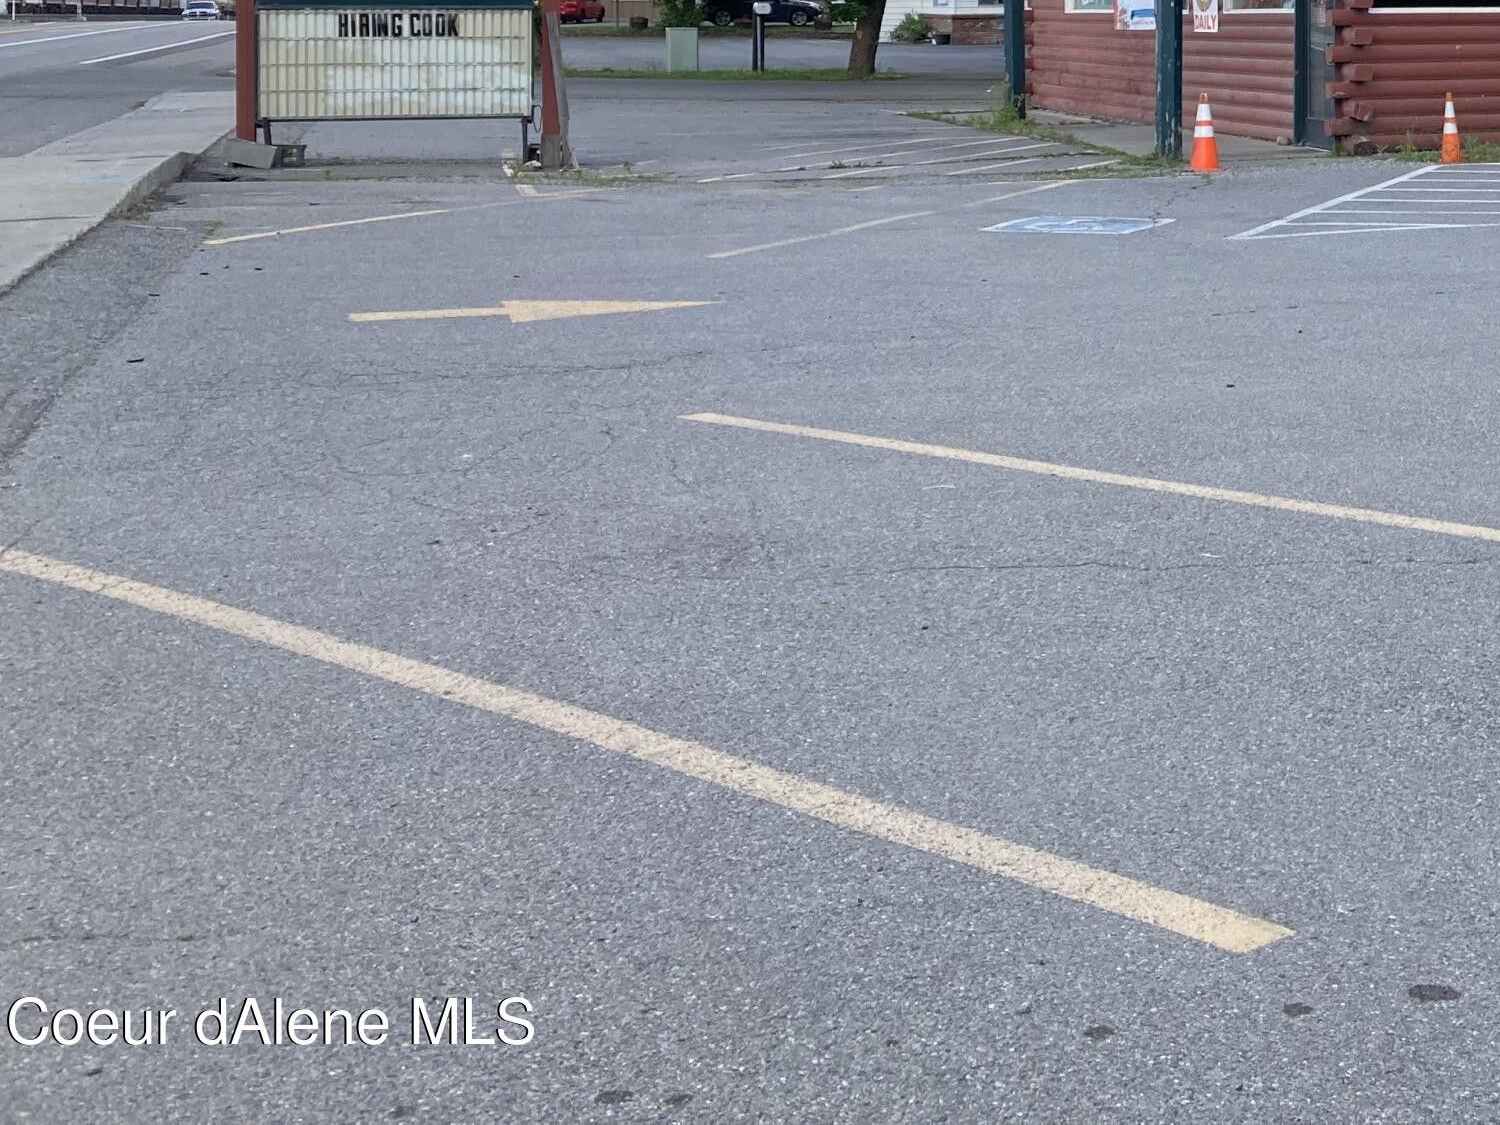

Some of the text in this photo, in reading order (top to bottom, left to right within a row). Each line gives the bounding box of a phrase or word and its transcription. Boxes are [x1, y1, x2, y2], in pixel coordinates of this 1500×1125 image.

[338, 13, 459, 37] HIRING COOK
[1194, 14, 1217, 30] DAILY
